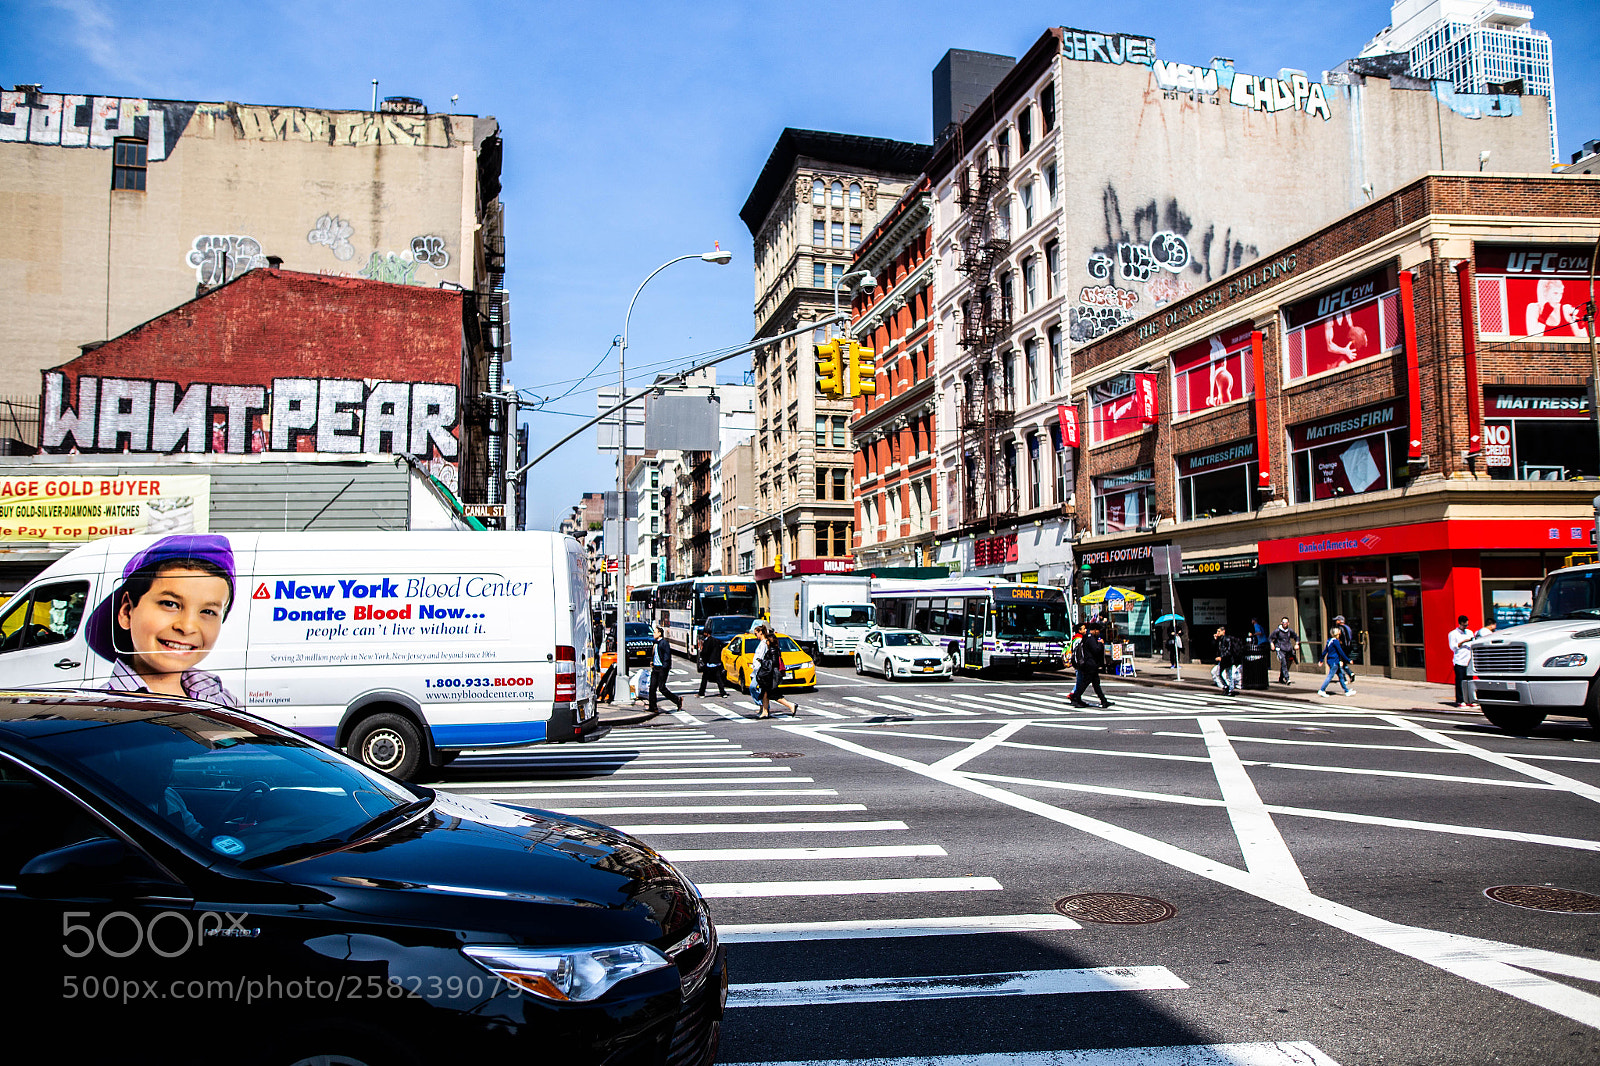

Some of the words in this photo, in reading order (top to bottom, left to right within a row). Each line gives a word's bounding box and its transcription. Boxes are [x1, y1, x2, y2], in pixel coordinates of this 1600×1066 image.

[1506, 252, 1559, 273] UFC
[1558, 257, 1589, 269] GYM
[1227, 253, 1298, 299] BUILDING
[1317, 286, 1352, 317] UFC
[1352, 281, 1374, 300] GYM
[1496, 394, 1589, 410] MATTRESSF
[270, 377, 459, 455] PEAR
[1484, 425, 1510, 445] NO
[1485, 445, 1511, 455] CREDIT
[1318, 462, 1338, 471] Change
[1486, 456, 1511, 467] NEEDED
[0, 481, 39, 496] AGE
[45, 481, 94, 496] GOLD
[100, 480, 161, 496] BUYER
[0, 505, 14, 518] BUY
[465, 506, 490, 516] CANAL
[492, 506, 503, 516] ST
[18, 526, 47, 538] Pay
[53, 526, 82, 537] Top
[88, 526, 135, 536] Dollar
[1298, 542, 1317, 553] Bank
[1317, 540, 1325, 551] of
[1326, 538, 1358, 551] America
[1082, 551, 1109, 564] PROPEL
[824, 561, 845, 571] MUJI
[274, 580, 335, 600] New
[338, 577, 399, 599] York
[405, 576, 462, 599] Blood
[466, 577, 533, 598] Center
[1012, 589, 1033, 598] CANAL
[1036, 590, 1044, 599] ST
[273, 606, 346, 622] Donate
[353, 604, 411, 621] Blood
[419, 604, 485, 620] Now...
[306, 624, 349, 640] people
[352, 623, 387, 637] can't
[392, 623, 416, 636] live
[420, 622, 469, 635] without
[474, 622, 486, 634] it.
[270, 654, 295, 664] Serving
[329, 652, 349, 662] people
[358, 653, 374, 661] New
[441, 651, 464, 660] beyond
[464, 650, 480, 659] since
[424, 677, 534, 688] 1.800.933.BLOOD
[425, 689, 535, 701] www.nybloodcenter.org
